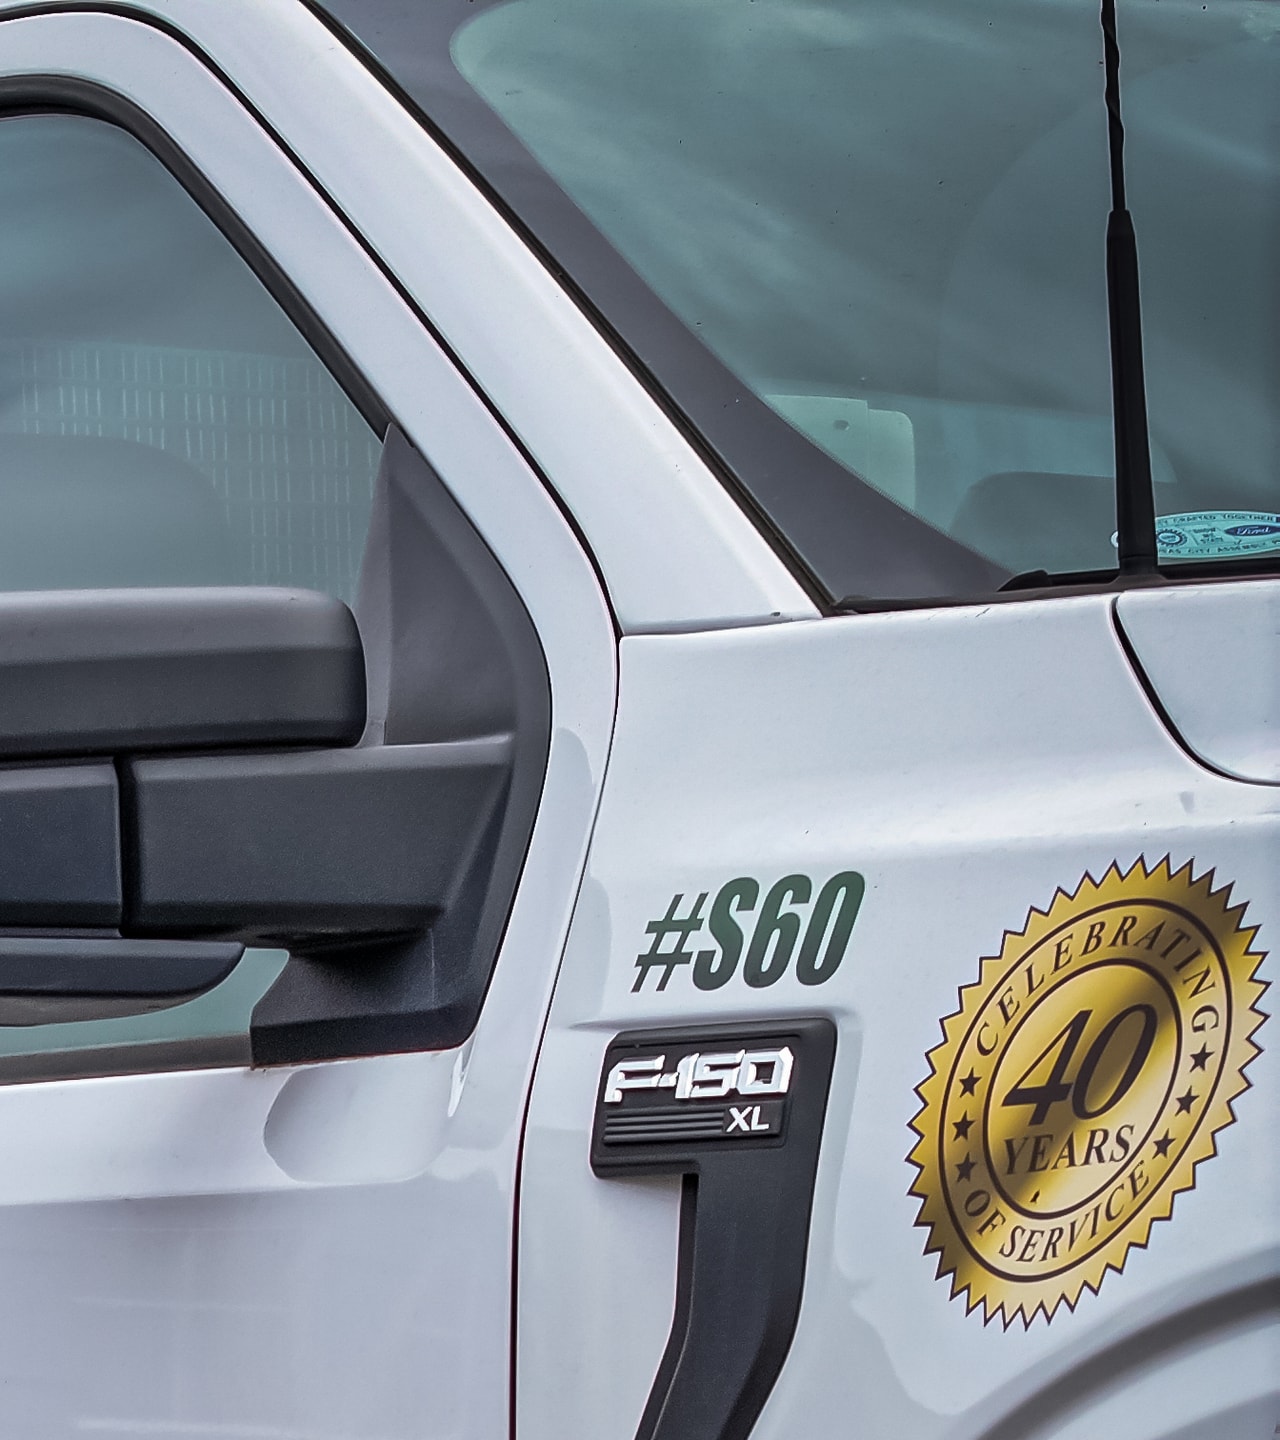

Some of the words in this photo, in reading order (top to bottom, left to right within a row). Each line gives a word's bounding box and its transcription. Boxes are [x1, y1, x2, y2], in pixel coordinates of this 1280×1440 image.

[1236, 525, 1272, 536] Ford
[631, 871, 865, 993] #S60
[976, 914, 1218, 1058] CELEBRATING
[604, 1046, 794, 1103] F-150
[1001, 1002, 1158, 1130] 40
[725, 1106, 770, 1134] XL
[1003, 1123, 1135, 1177] YEARS
[965, 1187, 1006, 1240] OF
[1000, 1160, 1151, 1263] SERVICE
